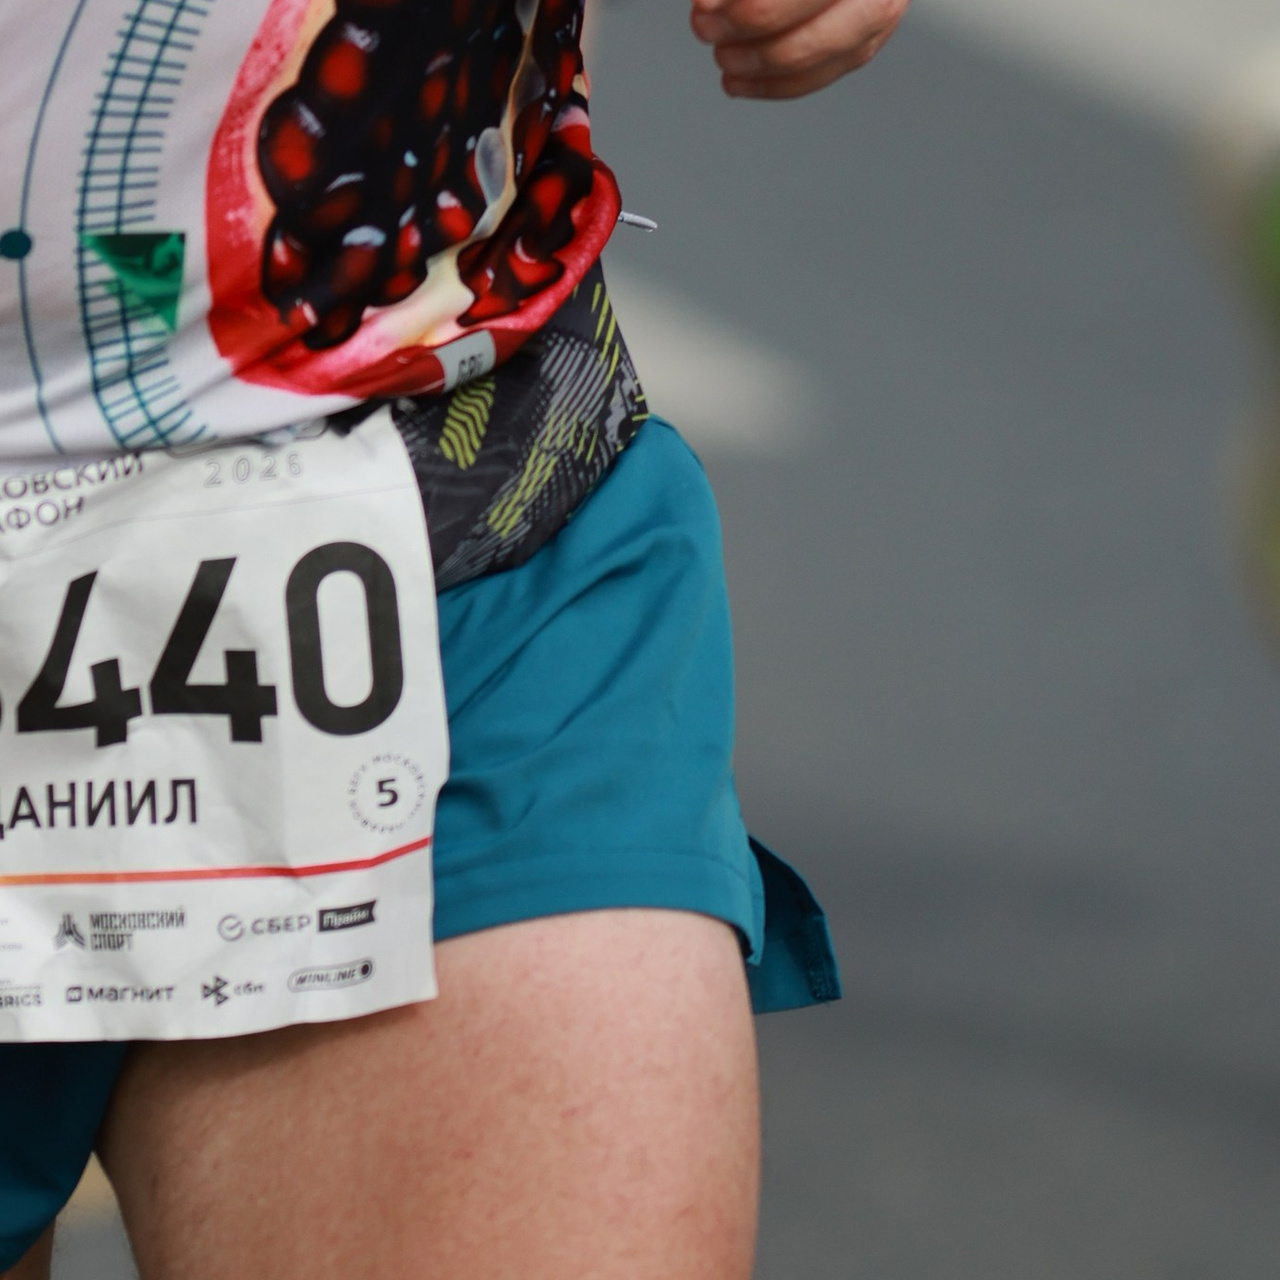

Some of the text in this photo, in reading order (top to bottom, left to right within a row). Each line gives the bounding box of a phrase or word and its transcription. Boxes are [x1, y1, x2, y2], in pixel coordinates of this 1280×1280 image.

[377, 778, 399, 807] 5
[89, 907, 186, 930] МОСКОВСКИЙ
[251, 914, 311, 935] СБЕР
[91, 933, 133, 951] СПОРТ
